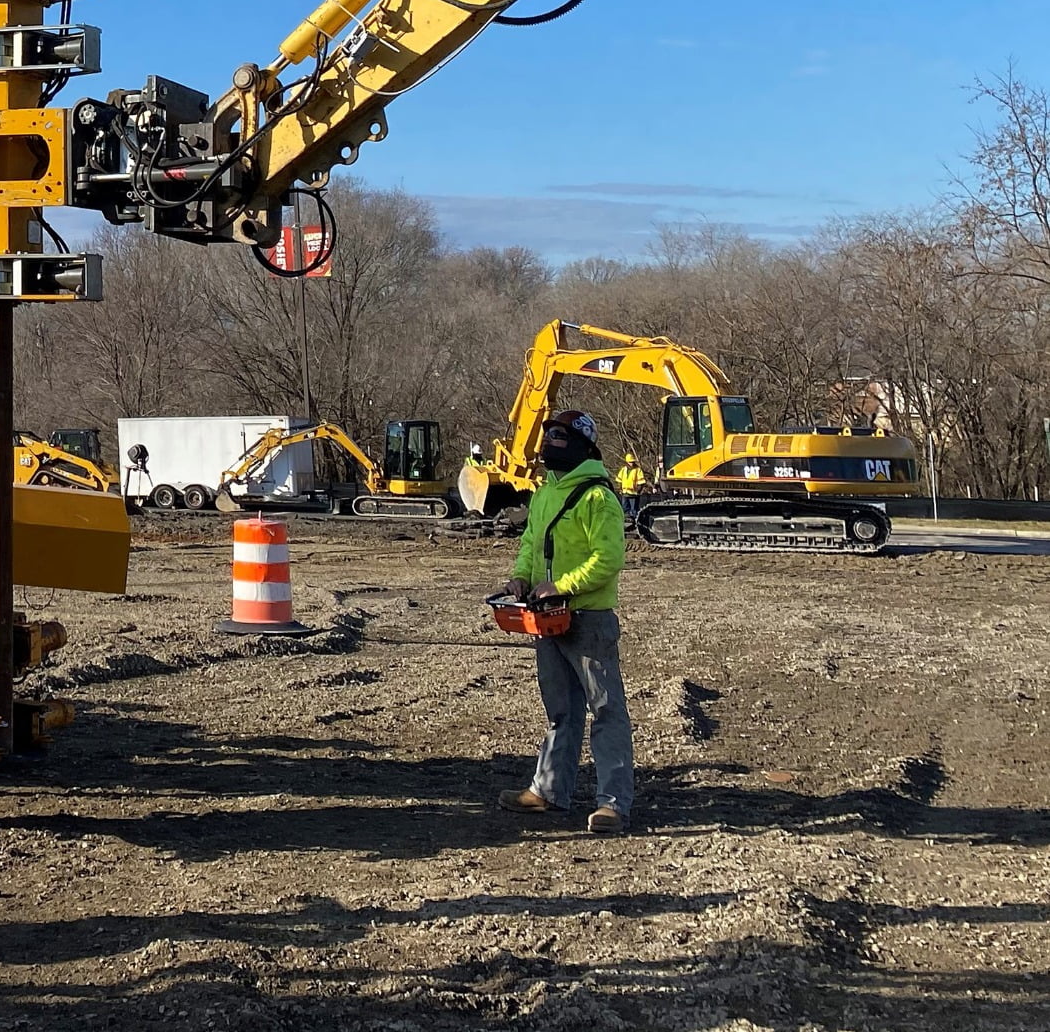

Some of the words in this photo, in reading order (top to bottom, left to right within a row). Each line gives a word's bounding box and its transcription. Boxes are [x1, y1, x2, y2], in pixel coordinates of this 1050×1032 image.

[599, 359, 614, 373] CAT
[744, 466, 760, 479] CAT
[865, 459, 891, 481] CAT
